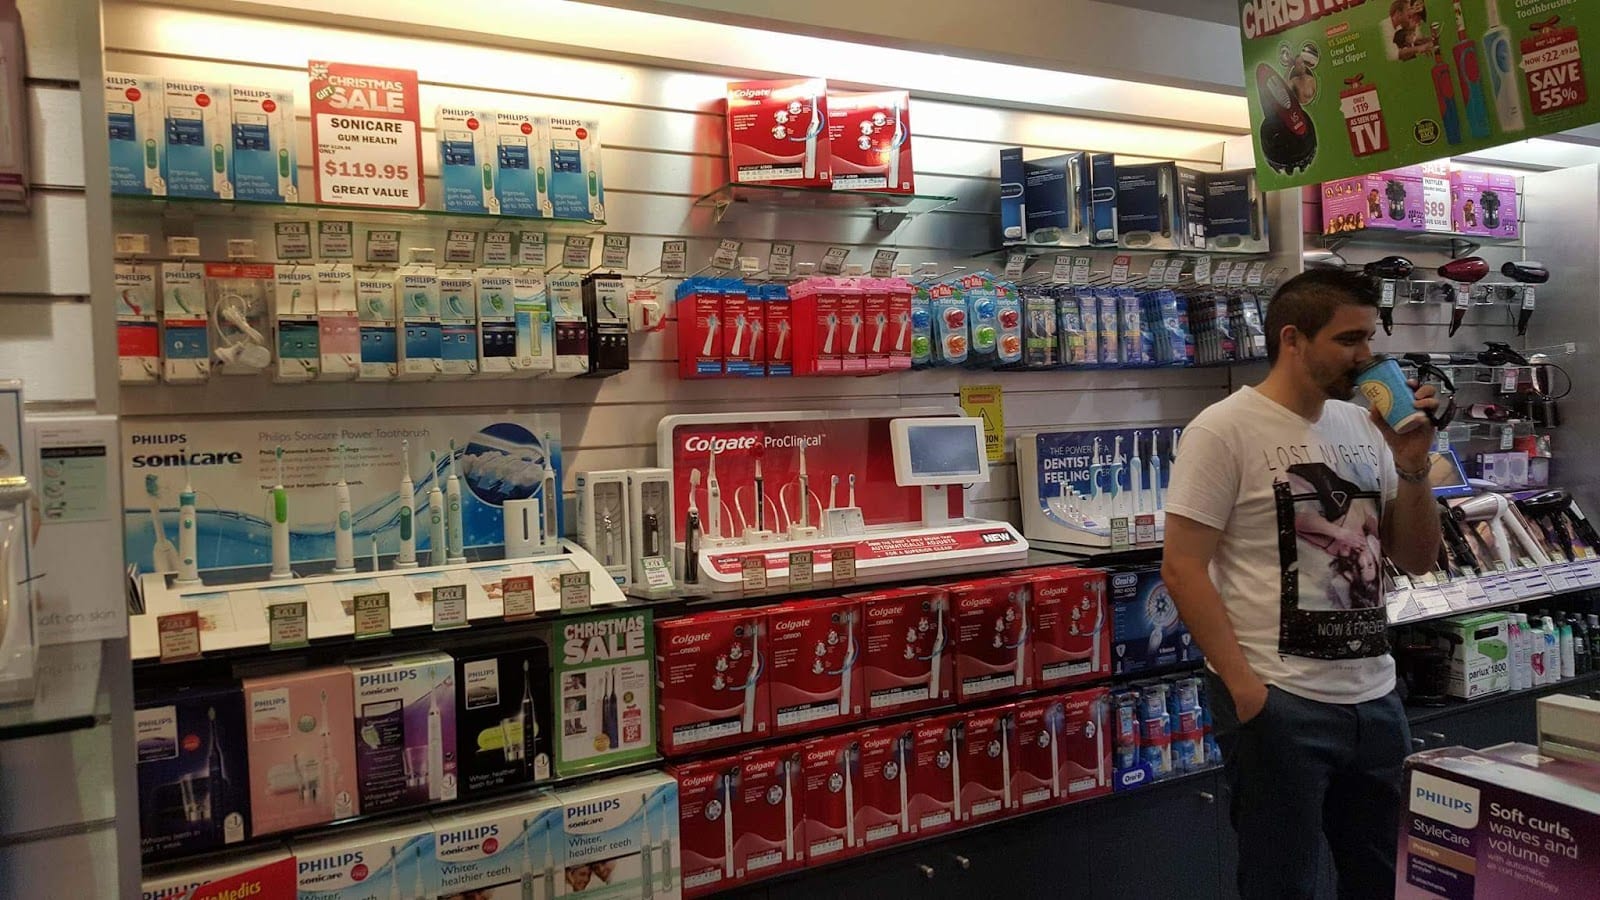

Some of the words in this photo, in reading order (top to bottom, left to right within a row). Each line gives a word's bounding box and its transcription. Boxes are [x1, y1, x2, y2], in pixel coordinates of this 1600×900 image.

[1524, 57, 1541, 66] NOW
[328, 75, 404, 92] CHRISTMAS
[1530, 62, 1580, 92] SAVE
[166, 82, 206, 92] PHILIPS
[233, 88, 271, 98] PHILIPS
[328, 86, 405, 114] SALE
[1541, 87, 1578, 110] 55%
[442, 108, 475, 117] PHILIPS
[498, 113, 529, 122] PHILIPS
[331, 117, 403, 133] SONICARE
[551, 118, 582, 127] PHILIPS
[338, 133, 360, 143] GUM
[362, 135, 398, 145] HEALTH
[1351, 121, 1383, 153] TV
[325, 159, 409, 180] $119.95
[332, 185, 369, 196] GREAT
[372, 187, 409, 198] VALUE
[115, 273, 152, 282] PHILIPS
[165, 271, 201, 280] PHILIPS
[278, 273, 312, 281] PHILIPS
[318, 272, 352, 280] PHILIPS
[404, 277, 437, 285] PHILIPS
[481, 278, 512, 286] PHILIPS
[514, 278, 541, 286] PHILIPS
[360, 281, 393, 289] PHILIPS
[441, 280, 472, 288] PHILIPS
[551, 280, 579, 288] PHILIPS
[597, 281, 625, 289] PHILIPS
[132, 434, 187, 445] PHILIPS
[258, 432, 290, 442] Philips
[294, 431, 338, 441] Sonicare
[341, 430, 372, 440] Power
[375, 428, 430, 438] Toothbrush
[685, 436, 756, 454] Colgate
[764, 434, 822, 449] ProClinical
[1050, 447, 1064, 455] THE
[1065, 446, 1092, 455] POWER
[132, 449, 242, 468] sonicare
[1044, 456, 1090, 470] DENTIST
[1263, 445, 1313, 471] LOST
[1320, 444, 1378, 466] NIGHTS
[1044, 470, 1090, 484] FEELING
[983, 532, 1011, 543] NEW
[871, 540, 925, 551] AUTOMATICALLY
[927, 538, 957, 547] ADJUSTS
[904, 547, 933, 555] SUPERIOR
[1040, 586, 1068, 597] Colgate
[961, 597, 992, 608] Colgate
[869, 606, 903, 617] Colgate
[564, 615, 644, 641] CHRISTMAS
[776, 619, 810, 631] Colgate
[1318, 623, 1344, 636] NOW
[671, 632, 711, 646] Colgate
[563, 631, 645, 665] SALE
[360, 669, 417, 687] PHILIPS
[468, 669, 495, 679] PHILIPS
[1468, 667, 1490, 681] parlux
[1491, 662, 1507, 673] 1800
[361, 686, 399, 696] sonicare
[254, 697, 286, 708] PHILIPS
[1066, 700, 1090, 709] Colgate
[1019, 709, 1044, 719] Colgate
[138, 718, 172, 729] PHILIPS
[969, 717, 995, 728] Colgate
[918, 728, 945, 738] Colgate
[864, 738, 891, 749] Colgate
[807, 749, 836, 761] Colgate
[745, 760, 776, 772] Colgate
[682, 774, 714, 787] Colgate
[1123, 771, 1144, 784] Oral-B
[1416, 787, 1473, 814] PHILIPS
[567, 799, 620, 819] PHILIPS
[568, 816, 604, 829] sonicare
[1490, 802, 1524, 826] Soft
[1528, 816, 1575, 842] curls,
[439, 824, 499, 845] PHILIPS
[1414, 818, 1471, 848] StyleCare
[569, 835, 601, 848] Whiter,
[1489, 821, 1540, 847] waves
[1544, 838, 1578, 859] and
[440, 842, 480, 857] sonicare
[569, 843, 608, 859] healthier
[609, 837, 632, 850] teeth
[1488, 837, 1550, 867] volume
[299, 851, 364, 874] PHILIPS
[442, 862, 478, 876] Whiter,
[299, 872, 343, 886] sonicare
[441, 871, 485, 887] healthier
[487, 865, 511, 878] teeth
